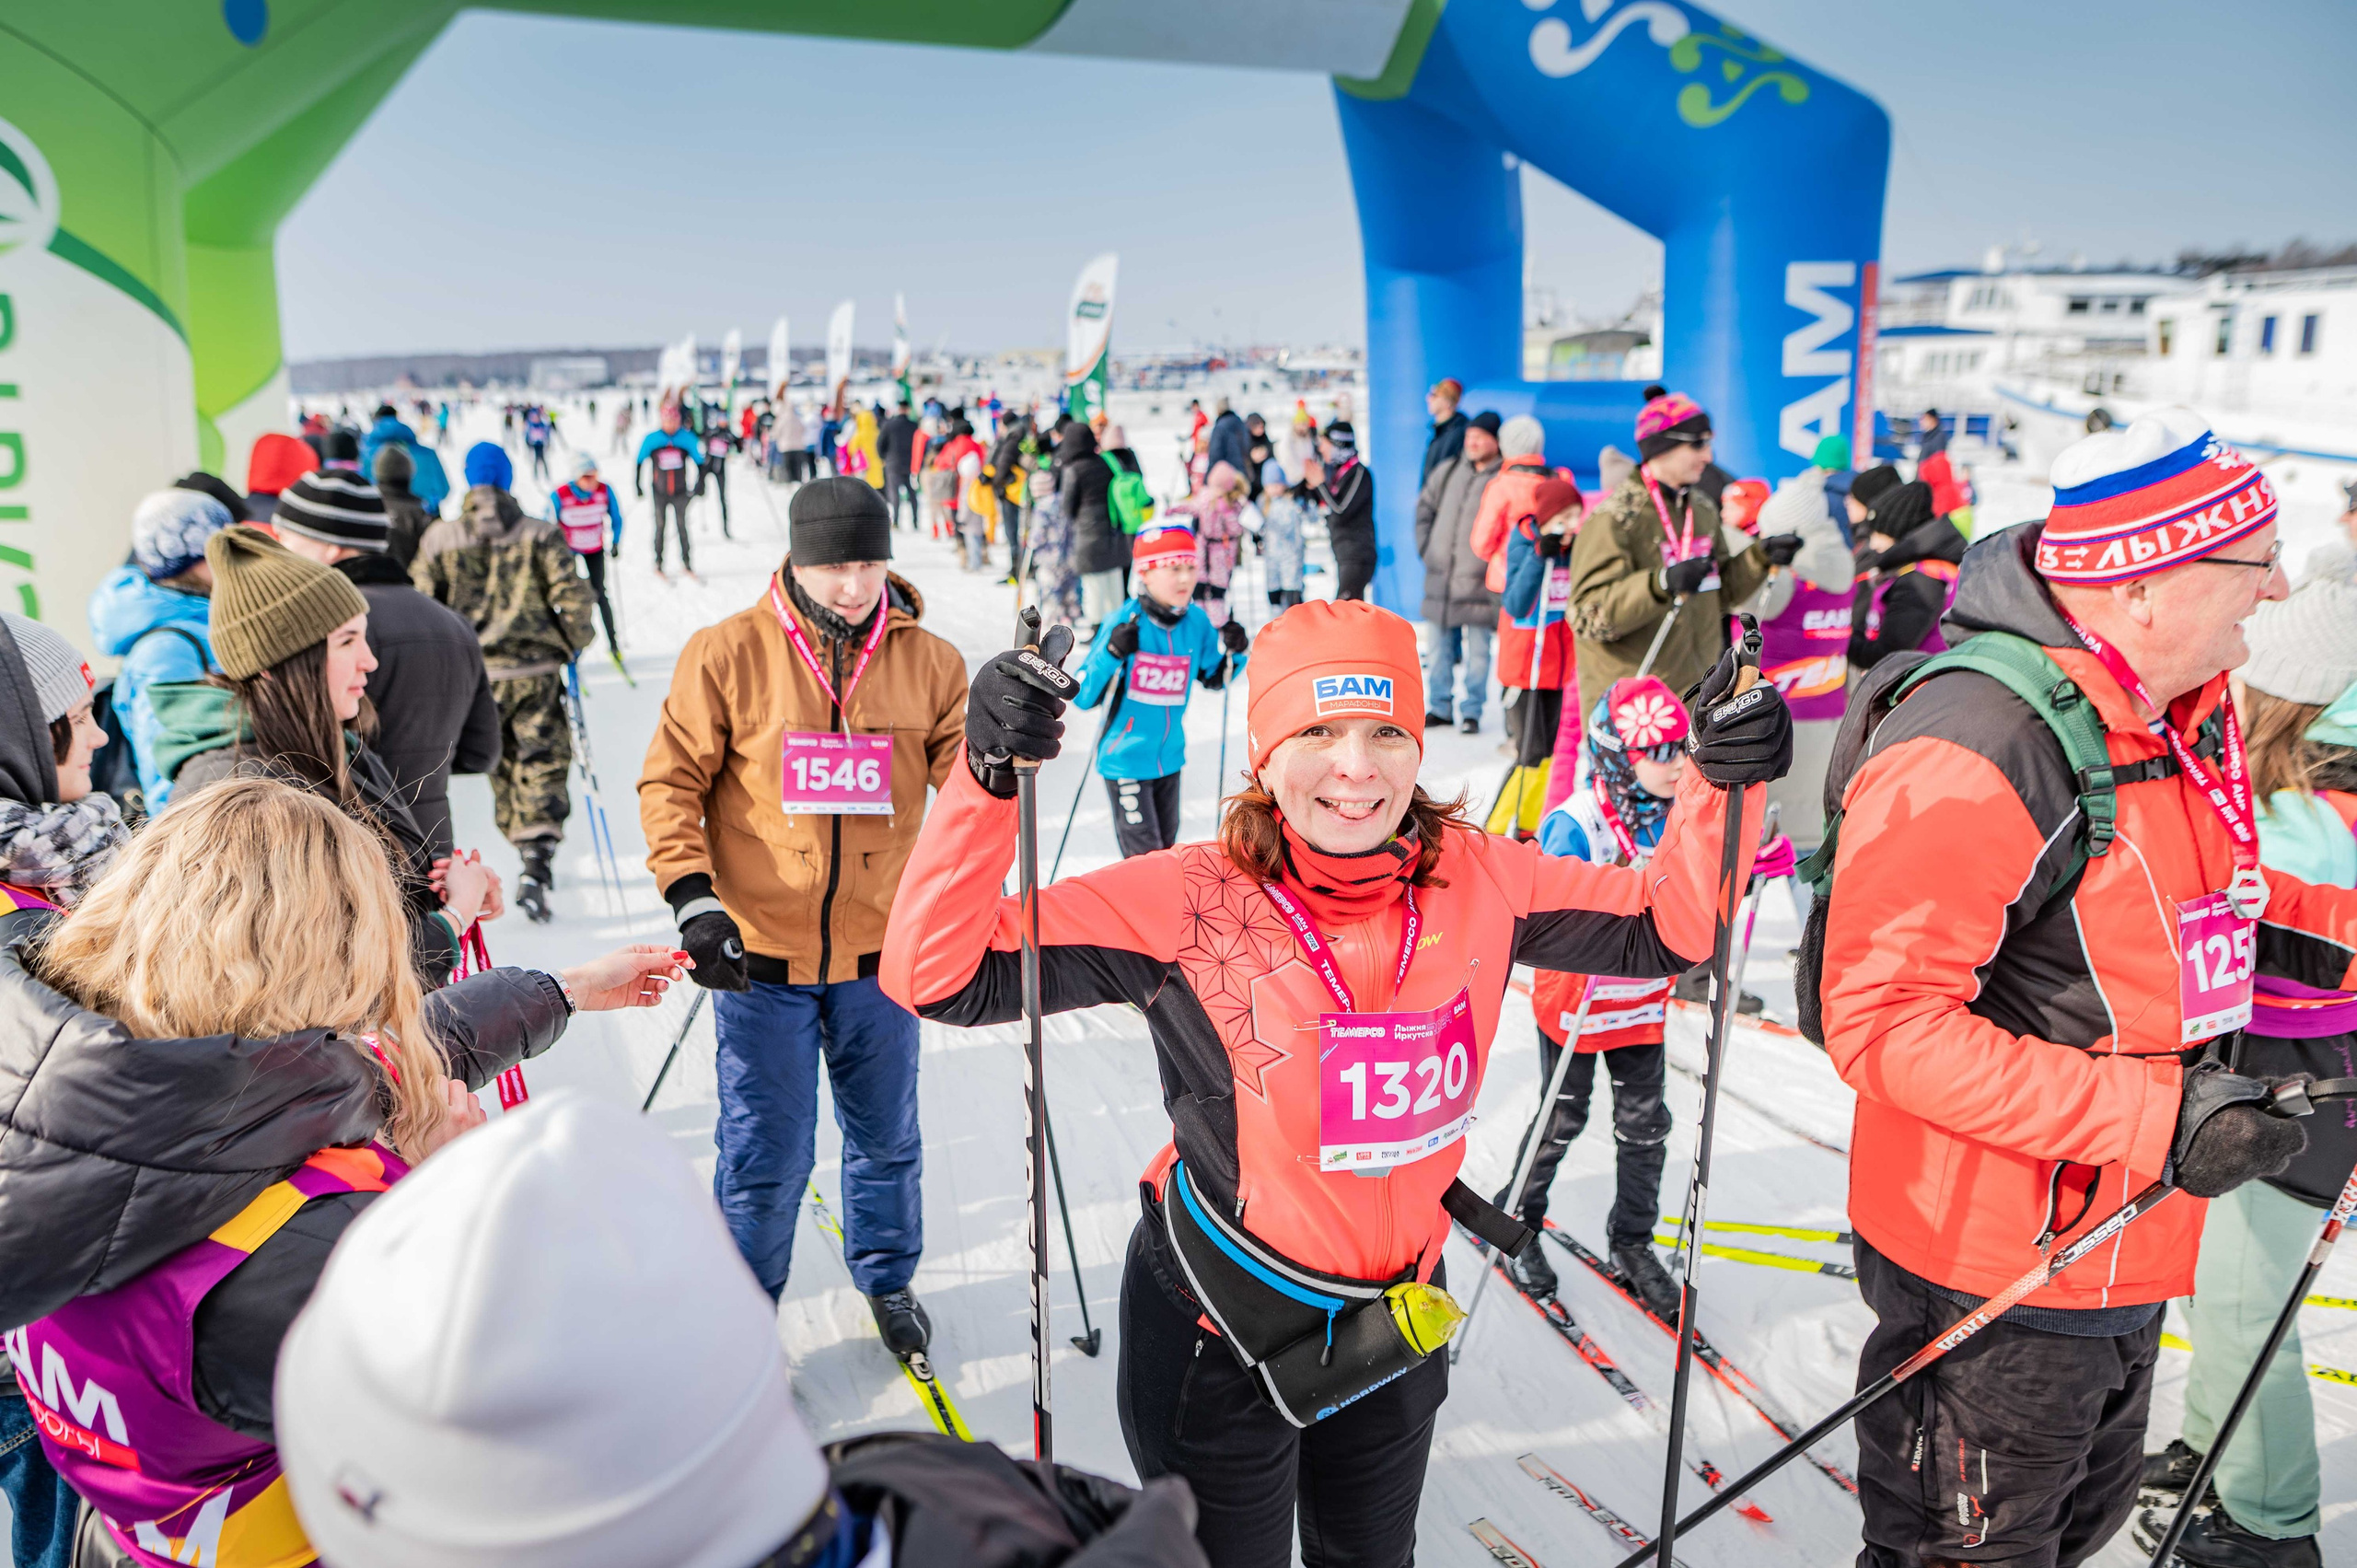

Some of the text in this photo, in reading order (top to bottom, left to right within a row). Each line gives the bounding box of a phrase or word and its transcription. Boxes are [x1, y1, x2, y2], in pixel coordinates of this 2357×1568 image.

[2096, 476, 2278, 570] ЛЫЖНЯ
[1136, 665, 1187, 691] 1242
[1316, 677, 1391, 699] БАМ
[1329, 700, 1381, 709] МАРАФОНЫ
[791, 756, 881, 793] 1546
[1397, 916, 1417, 984] ТЕМЕРСО
[1454, 1000, 1467, 1015] БАМ
[1330, 1027, 1386, 1038] ТЕМЕРСО
[1394, 1024, 1426, 1032] Лыжня
[1394, 1028, 1434, 1041] Иркутска
[1340, 1041, 1469, 1121] 1320
[2065, 1203, 2139, 1264] classic
[1340, 1366, 1408, 1408] NORDWAY
